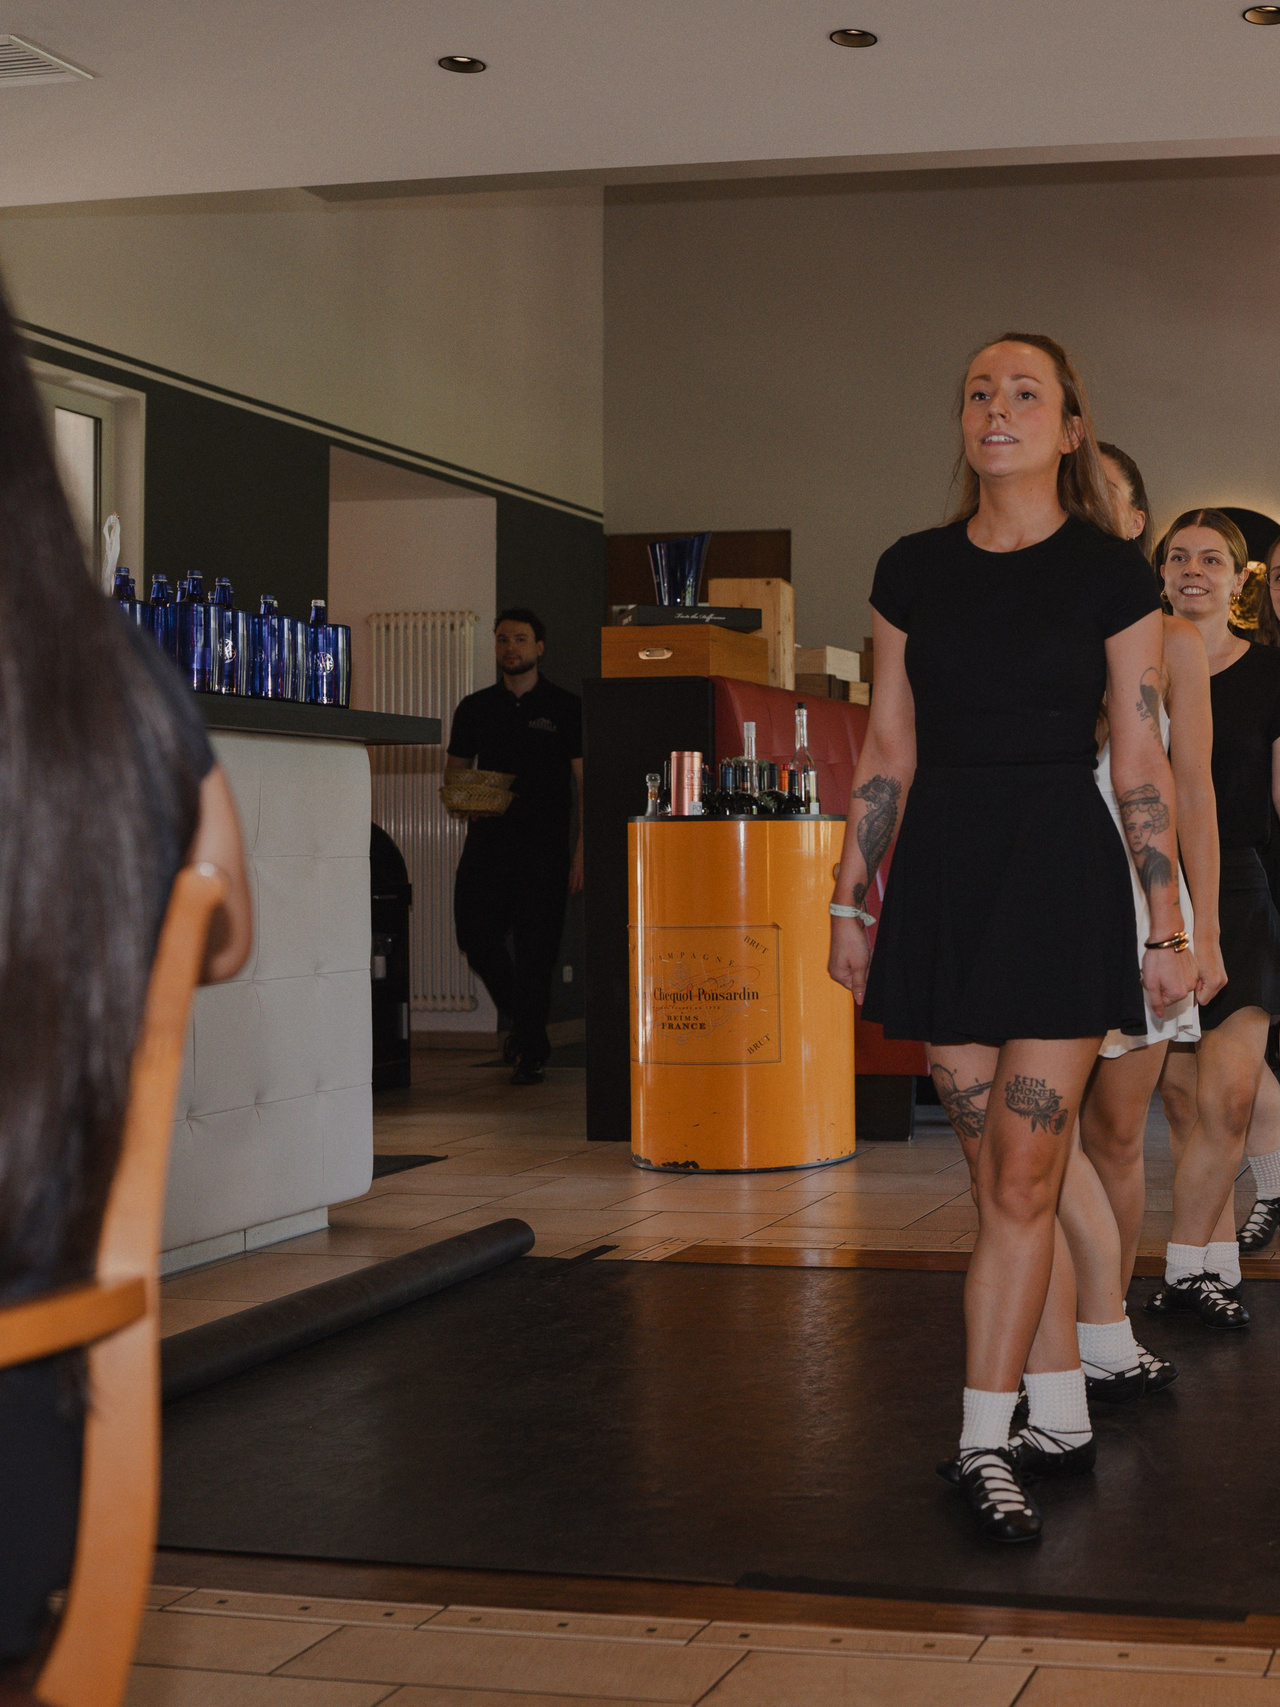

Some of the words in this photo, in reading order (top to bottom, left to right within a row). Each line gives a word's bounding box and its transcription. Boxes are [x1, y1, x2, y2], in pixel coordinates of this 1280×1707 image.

[743, 935, 769, 955] BRUT
[697, 986, 760, 1001] Ponsardin
[661, 1022, 706, 1030] FRANCE
[747, 1034, 771, 1054] BRUT
[1014, 1074, 1046, 1089] KEIN
